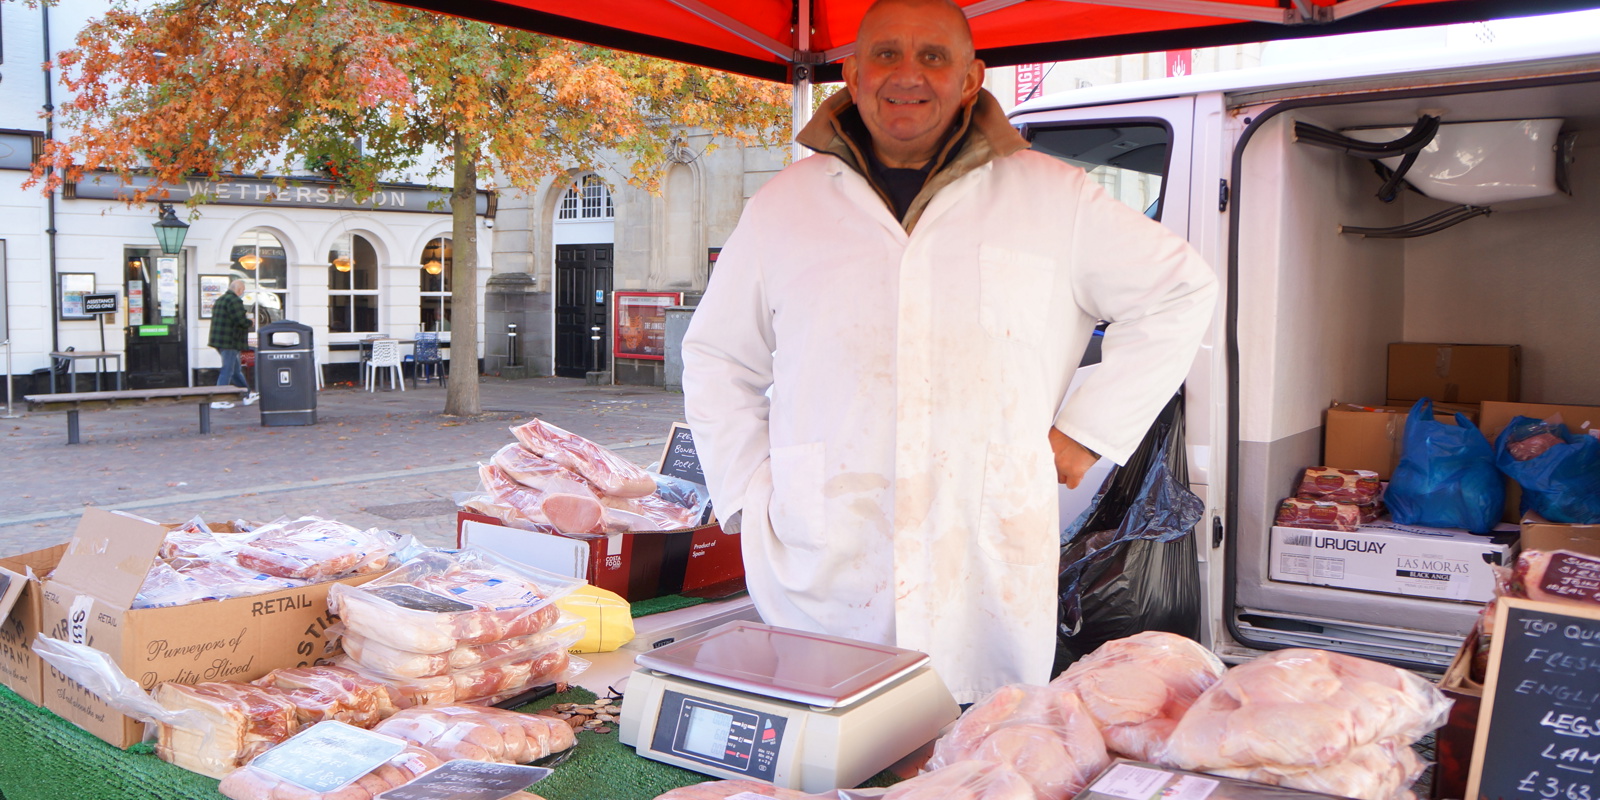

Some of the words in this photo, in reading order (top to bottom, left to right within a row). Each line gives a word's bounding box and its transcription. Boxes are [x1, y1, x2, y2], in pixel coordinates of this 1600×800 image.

[186, 180, 406, 208] WETHERSPOON
[673, 460, 694, 469] PORK
[1314, 536, 1387, 554] URUGUAY
[692, 550, 705, 558] Spain
[1397, 558, 1419, 569] LAS
[1422, 560, 1469, 574] MORAS
[44, 591, 59, 604] RETAIL
[252, 594, 312, 617] RETAIL
[98, 612, 117, 627] RETAIL
[1519, 618, 1557, 634] TOP
[146, 639, 226, 661] Purveyors
[228, 627, 247, 652] of
[204, 655, 254, 680] Sliced
[1540, 710, 1600, 734] LEGS
